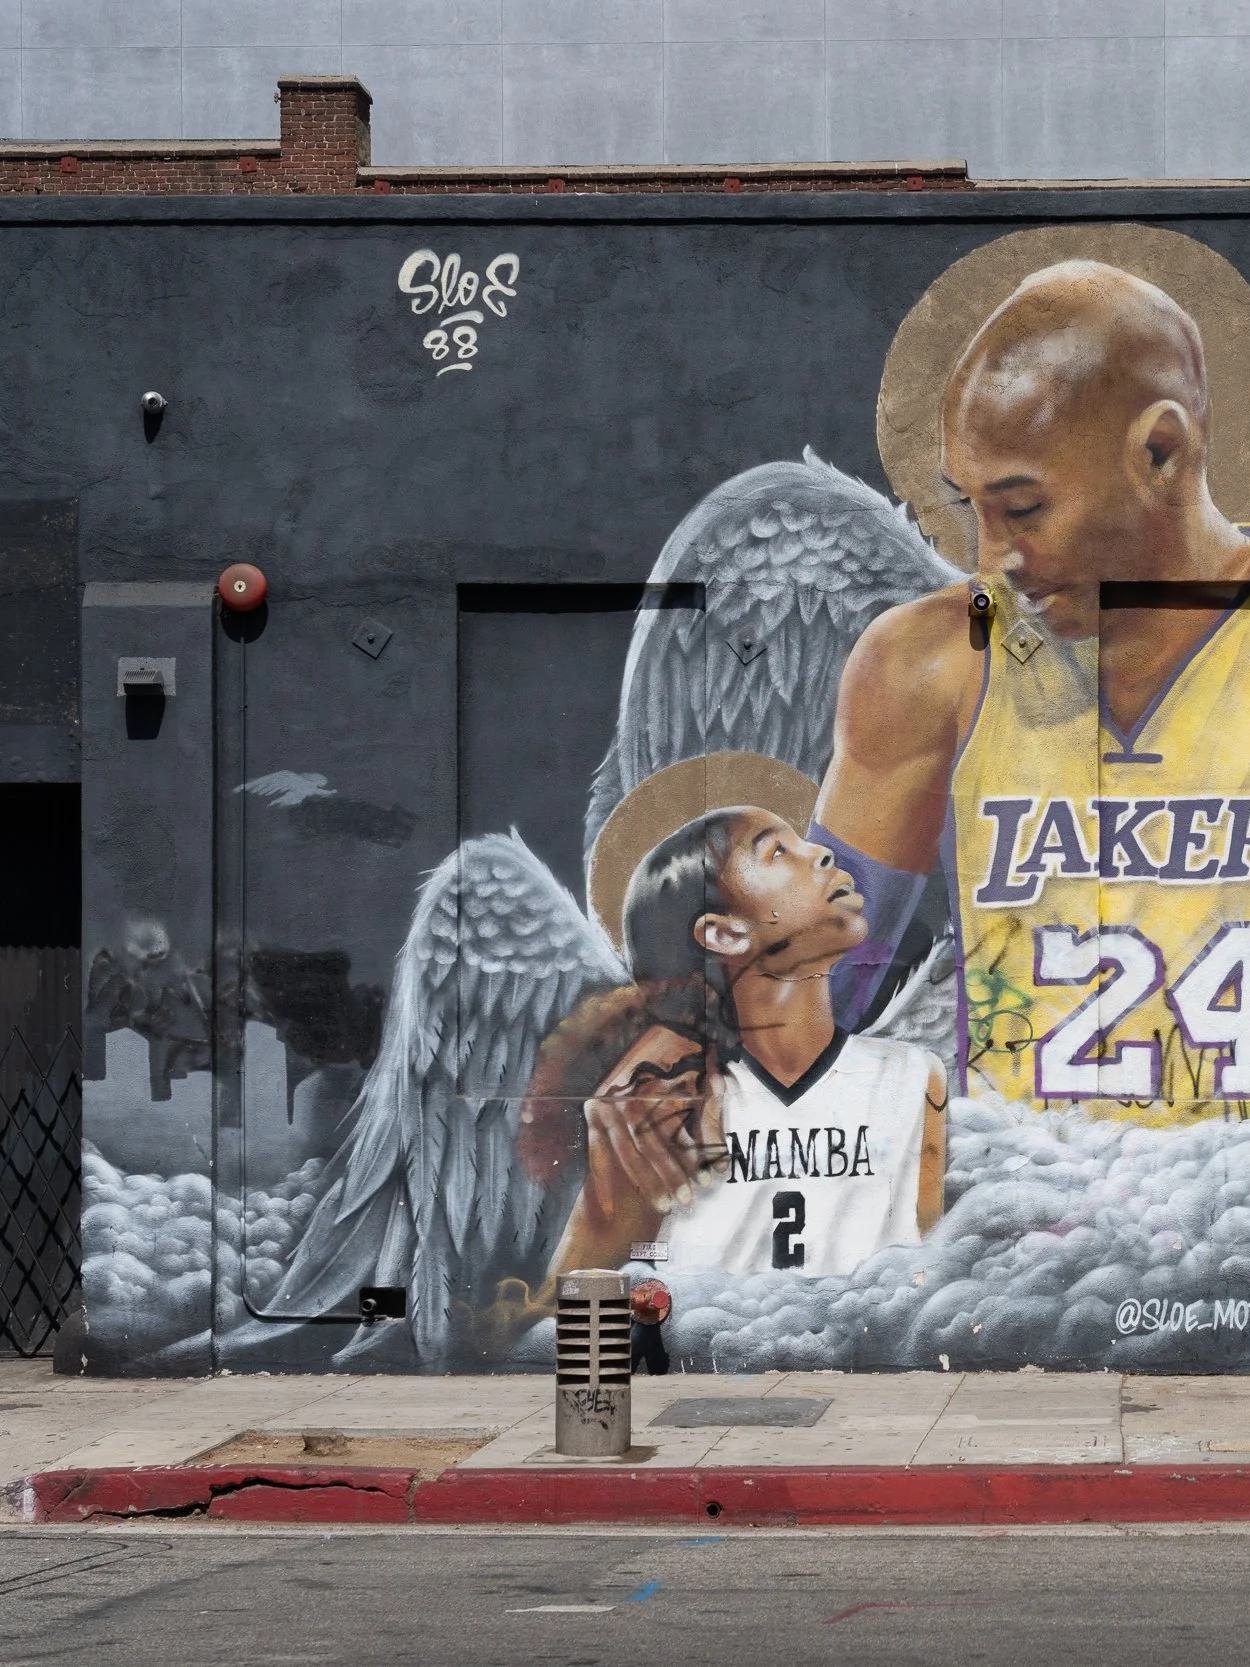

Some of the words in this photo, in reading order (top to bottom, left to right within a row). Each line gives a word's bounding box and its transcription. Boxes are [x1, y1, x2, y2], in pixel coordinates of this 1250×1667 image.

[423, 326, 478, 360] 88
[726, 1125, 875, 1183] MAMBA
[771, 1191, 806, 1270] 2
